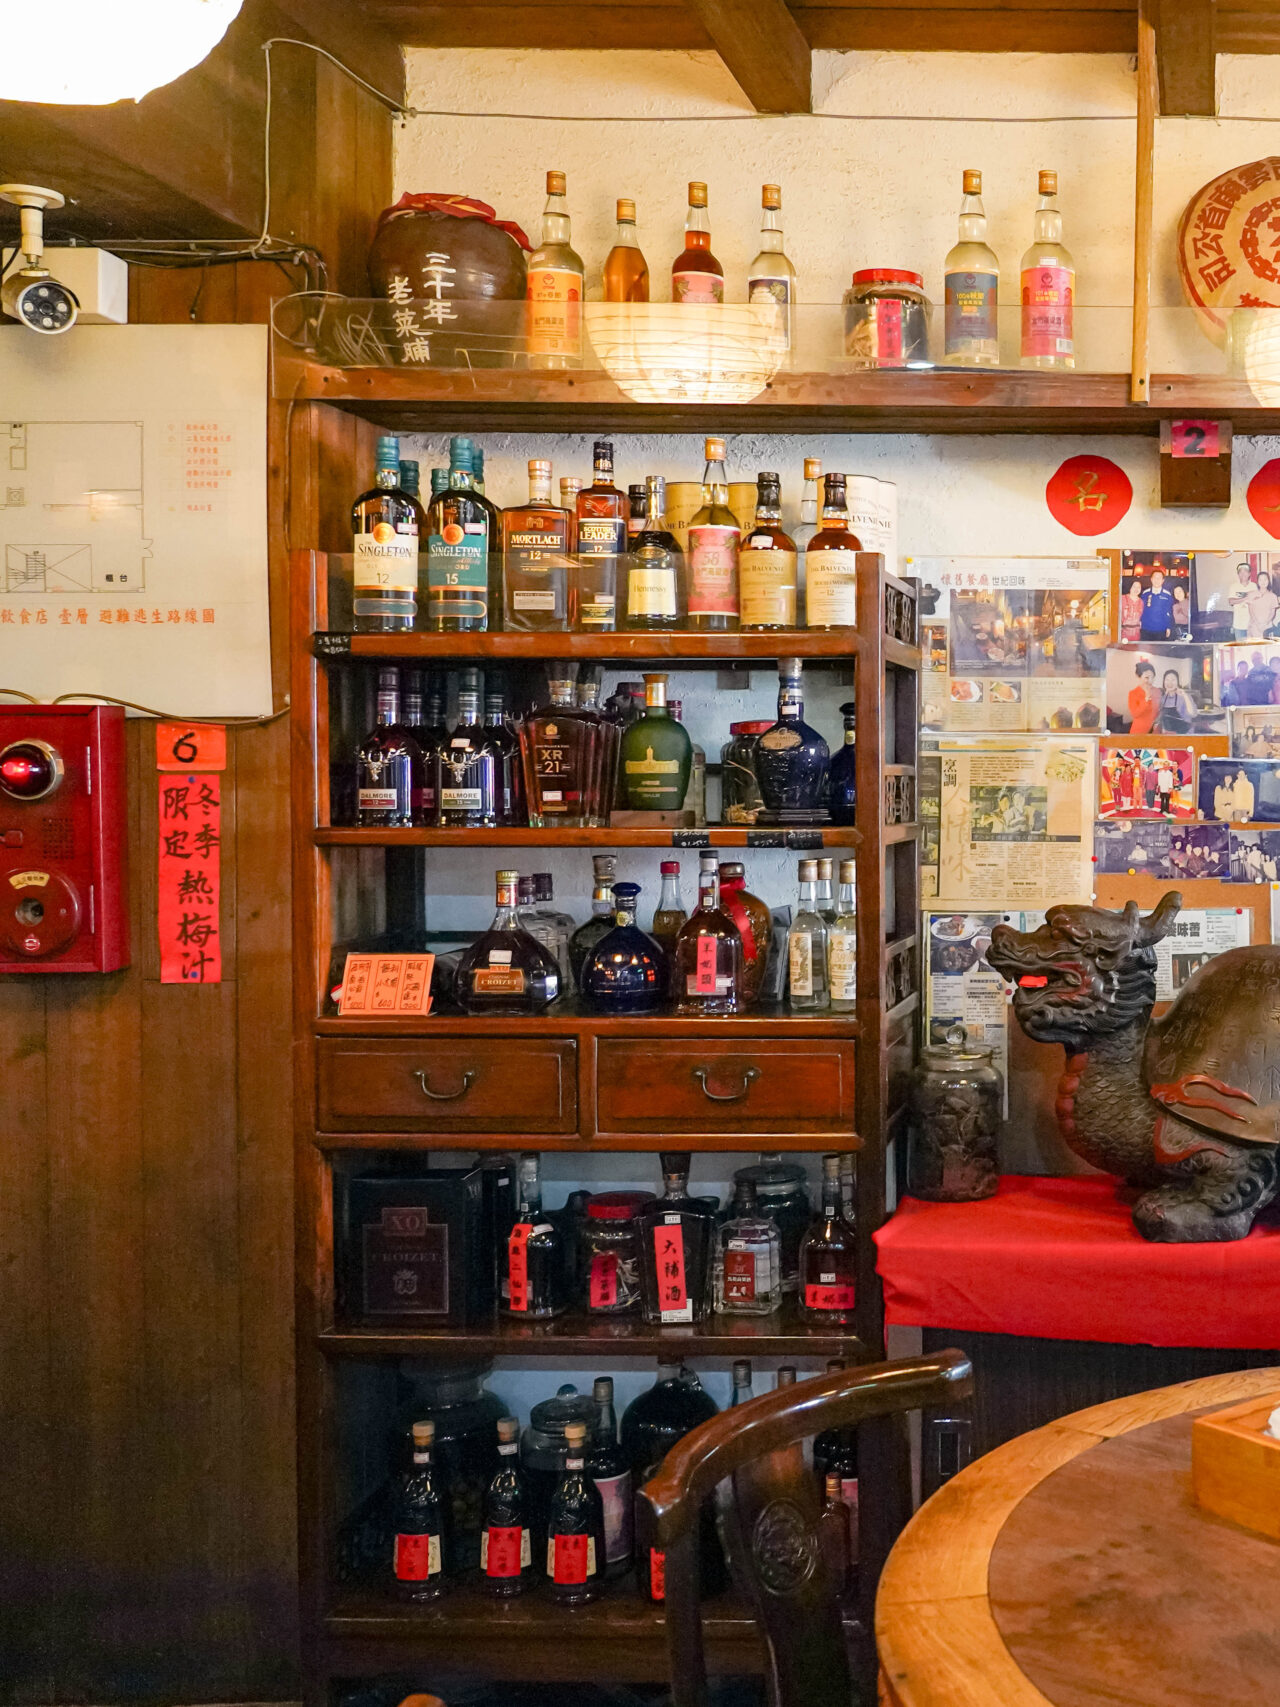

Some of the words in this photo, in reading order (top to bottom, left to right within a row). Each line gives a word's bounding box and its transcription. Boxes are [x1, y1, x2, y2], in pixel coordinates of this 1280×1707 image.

[421, 251, 458, 325] 三十年
[388, 275, 433, 364] 老菜脯
[1184, 427, 1206, 454] 2
[1069, 470, 1107, 513] 名
[510, 534, 562, 545] MORTLACH
[580, 531, 617, 541] LEADER
[358, 544, 412, 558] SINGLETON
[430, 545, 482, 558] SINGLETON
[529, 551, 541, 560] 12
[377, 573, 390, 584] 12
[445, 573, 459, 585] 15
[941, 574, 989, 586] 懷舊餐廳
[992, 575, 1026, 587] 世紀回味
[58, 607, 89, 625] 壹層
[99, 607, 216, 625] 避難逃生路線圖
[173, 732, 198, 763] 6
[541, 750, 562, 760] XR
[544, 761, 560, 773] 21
[943, 758, 957, 787] 烹調
[163, 786, 193, 859] 限定
[193, 784, 220, 859] 冬季
[176, 870, 218, 983] 熱梅汁
[391, 1215, 420, 1230] XO
[663, 1240, 681, 1301] 大補酒
